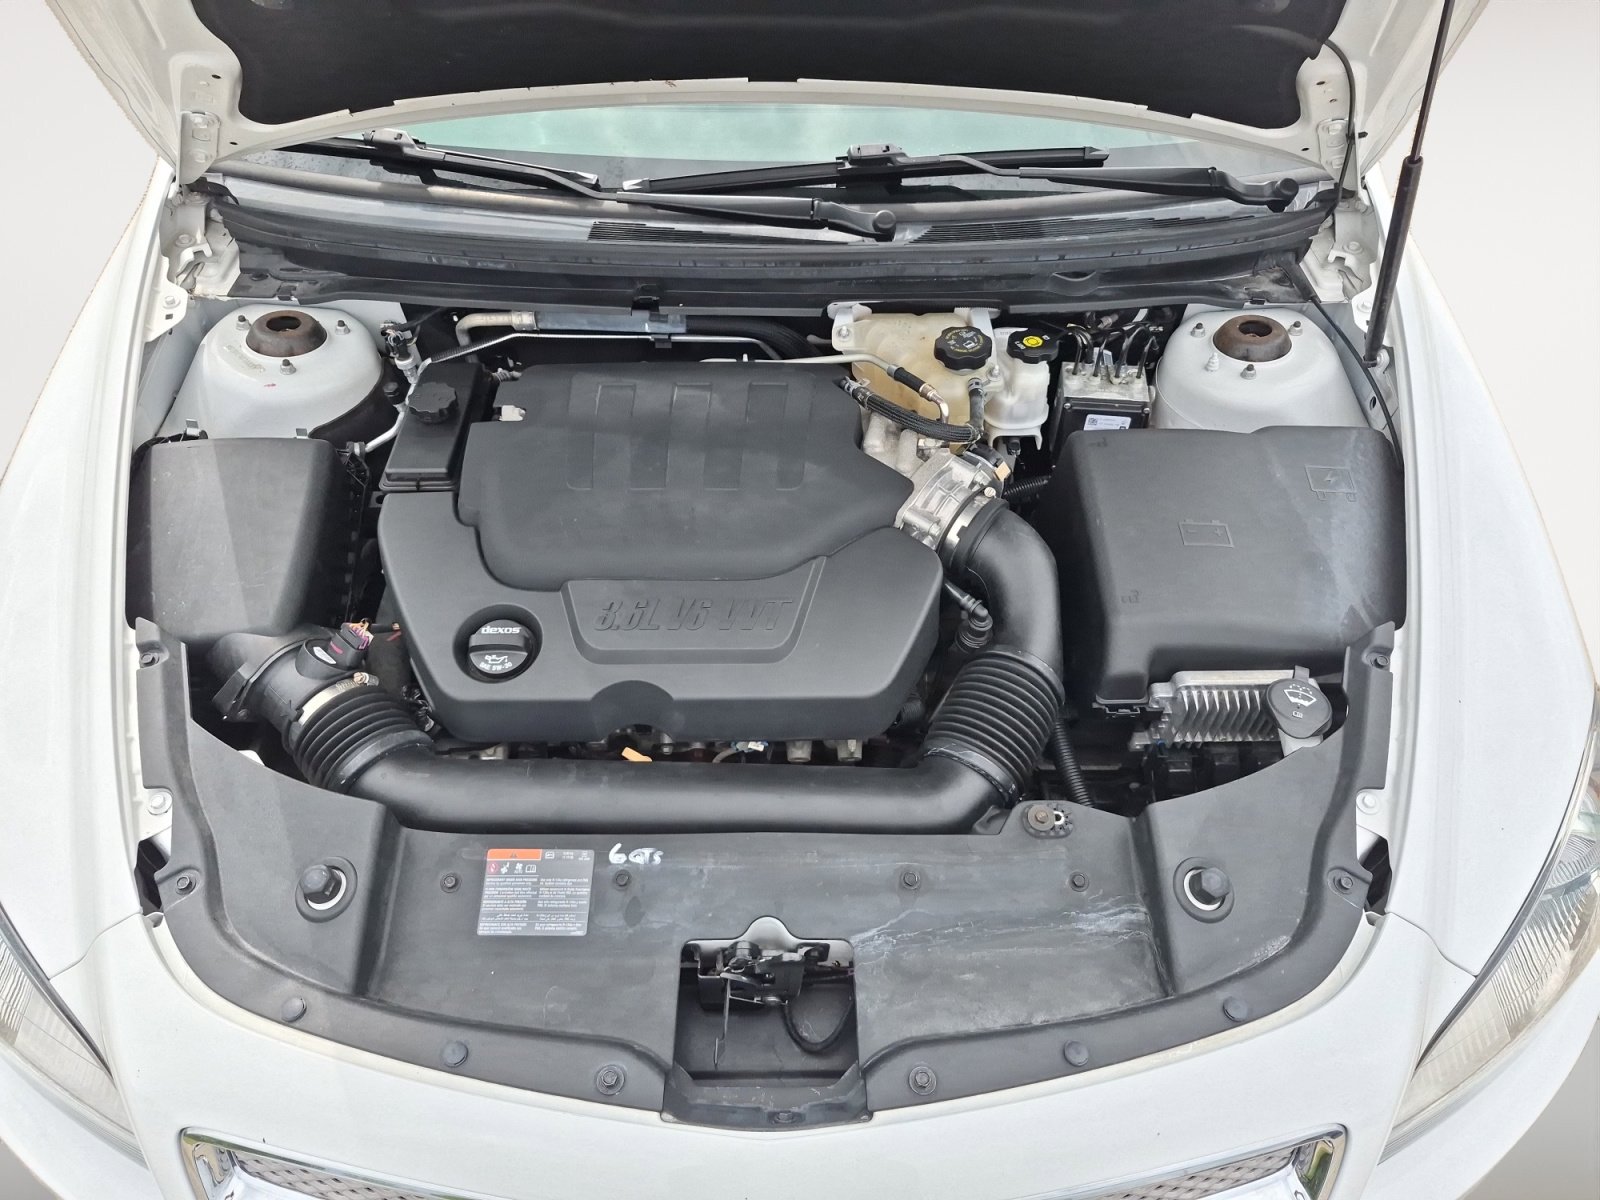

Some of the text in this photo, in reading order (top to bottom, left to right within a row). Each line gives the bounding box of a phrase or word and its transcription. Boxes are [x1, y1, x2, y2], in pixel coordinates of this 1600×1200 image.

[594, 598, 793, 632] 3.6L V6 VVT
[480, 625, 522, 634] dexos
[479, 661, 492, 671] SAE
[608, 842, 628, 864] 6
